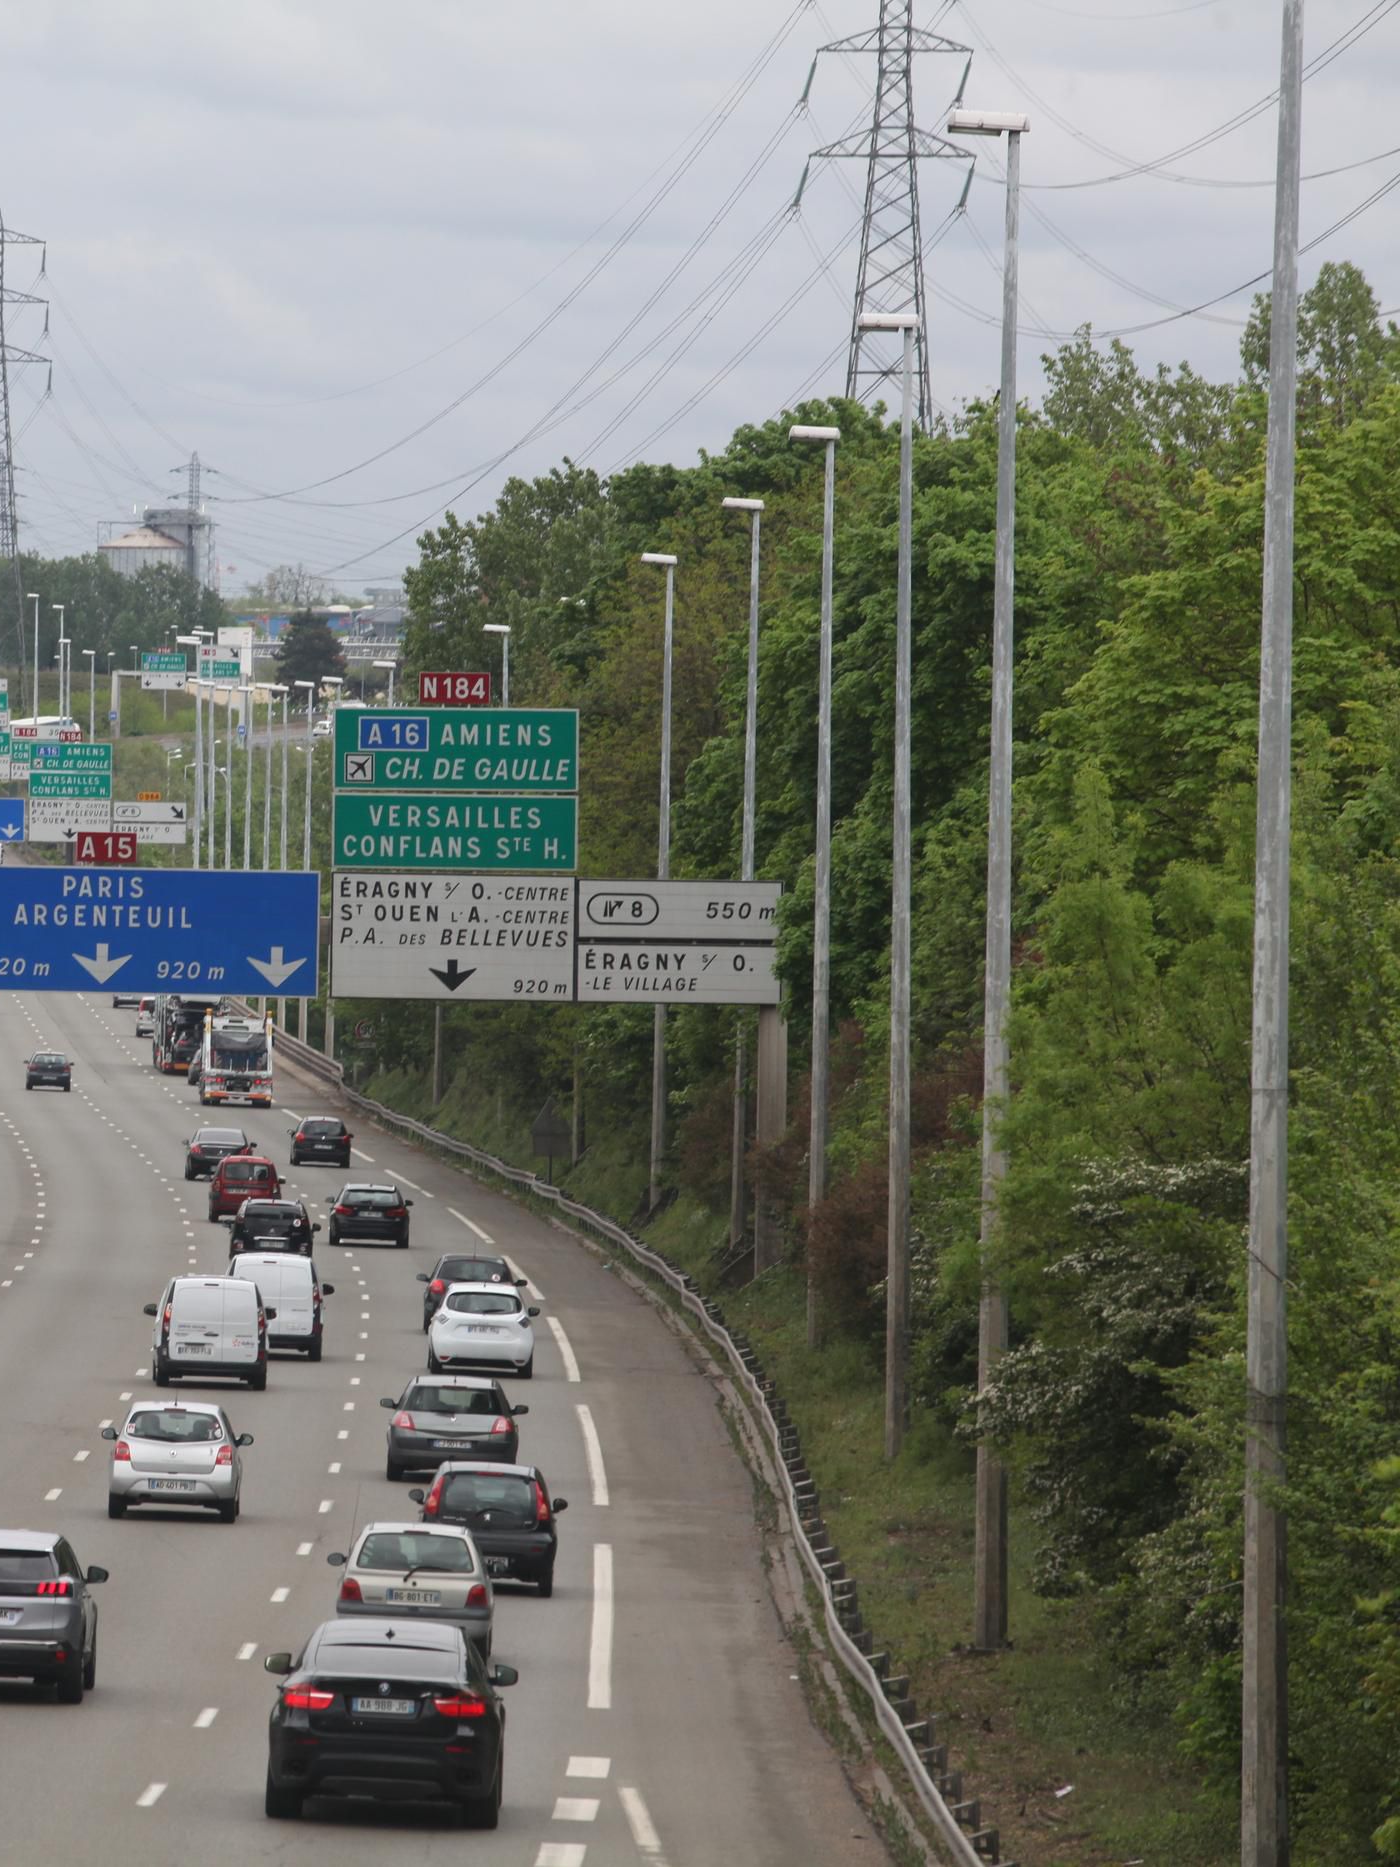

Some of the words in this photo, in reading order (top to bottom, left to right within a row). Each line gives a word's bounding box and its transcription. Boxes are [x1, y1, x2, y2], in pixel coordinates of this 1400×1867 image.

[440, 724, 552, 746] AMIENS
[66, 747, 105, 756] AMIENS
[63, 760, 74, 769] DE
[77, 760, 109, 769] GAULLE
[385, 758, 423, 780] CH.
[433, 759, 466, 780] DE
[475, 759, 570, 781] GAULLE
[41, 776, 100, 785] VERSAILLES
[32, 786, 80, 795] CONFLANS
[369, 805, 542, 829] VERSAILLES
[343, 836, 481, 858] CONFLANS
[544, 839, 568, 860] H.
[63, 876, 144, 898] PARIS
[340, 878, 432, 900] ÉRAGNY
[14, 903, 192, 929] ARGENTEUIL
[374, 904, 439, 923] OUEN
[631, 901, 643, 918] 8
[706, 902, 752, 919] 550
[399, 934, 426, 945] DES
[440, 929, 568, 948] BELLEVUES
[585, 949, 686, 970] ÉRAGNY
[33, 964, 50, 976] m
[156, 961, 200, 980] 920
[207, 967, 225, 981] m
[513, 979, 548, 994] 920
[553, 983, 567, 994] m
[624, 977, 698, 992] VILLAGE
